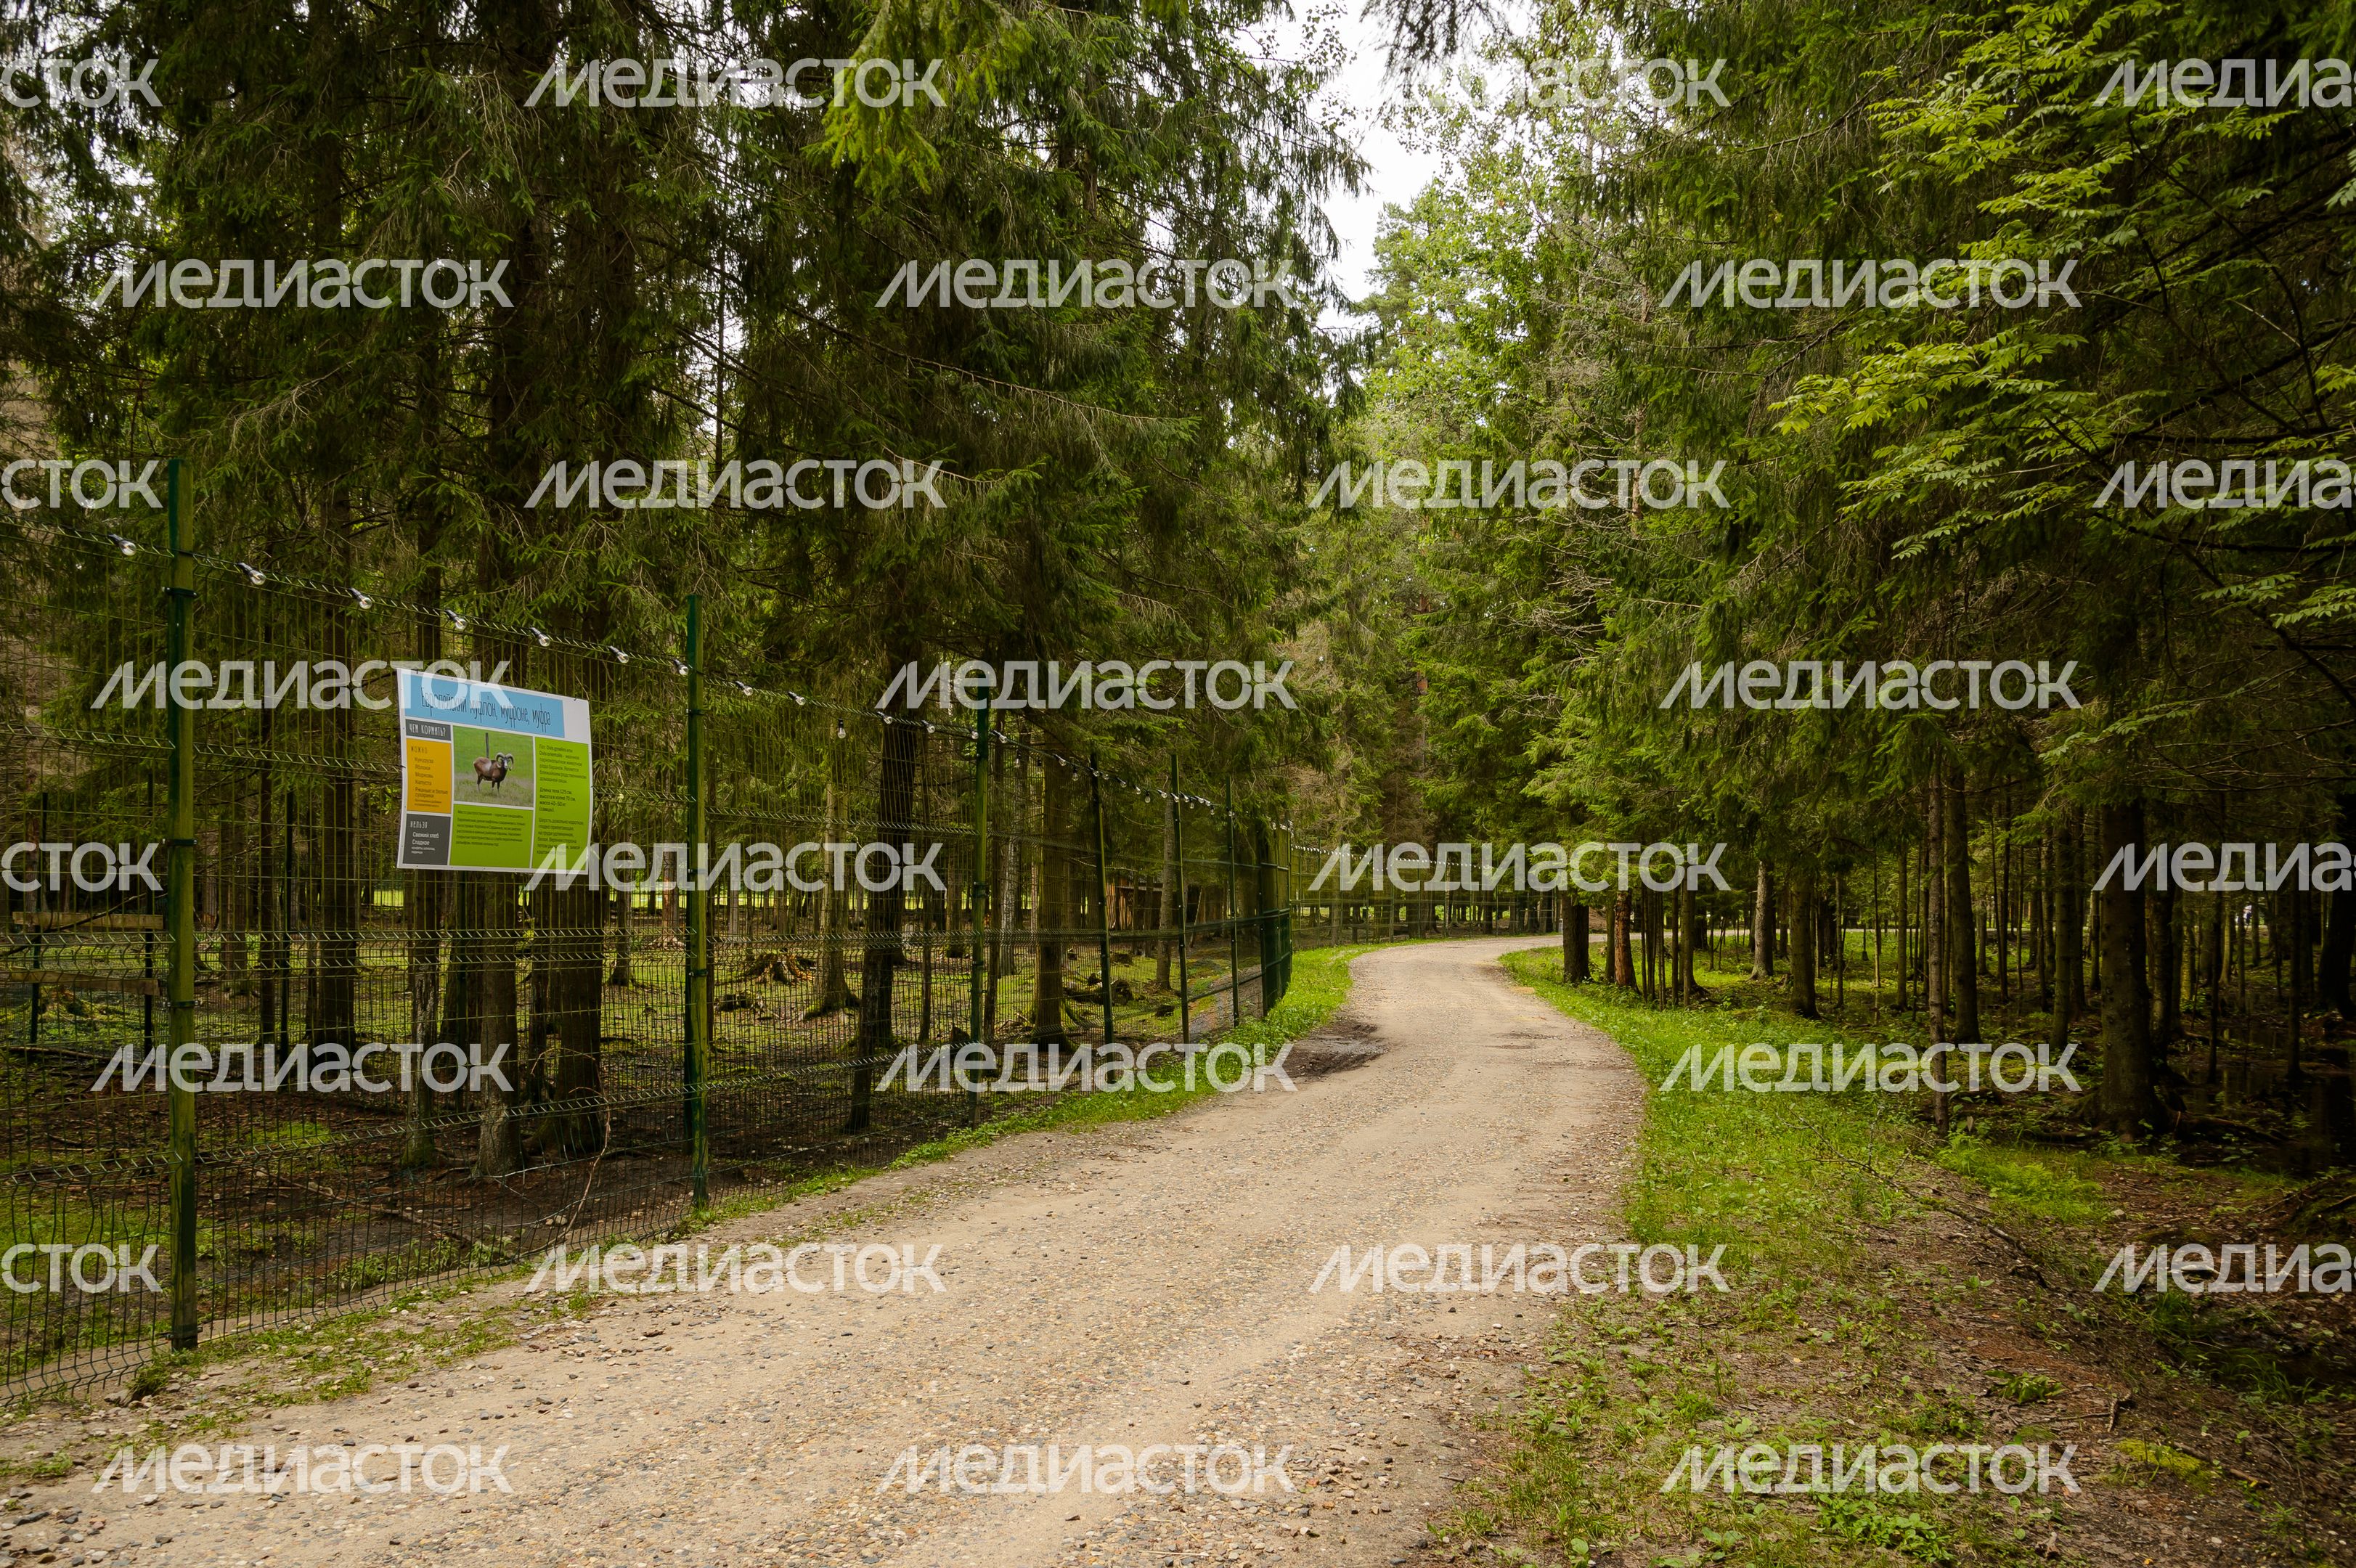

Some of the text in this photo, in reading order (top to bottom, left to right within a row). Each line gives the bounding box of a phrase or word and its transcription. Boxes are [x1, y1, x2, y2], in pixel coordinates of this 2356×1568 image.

[532, 703, 551, 732] муфра
[409, 723, 446, 737] ЧЕМ КОРМИТЬ?
